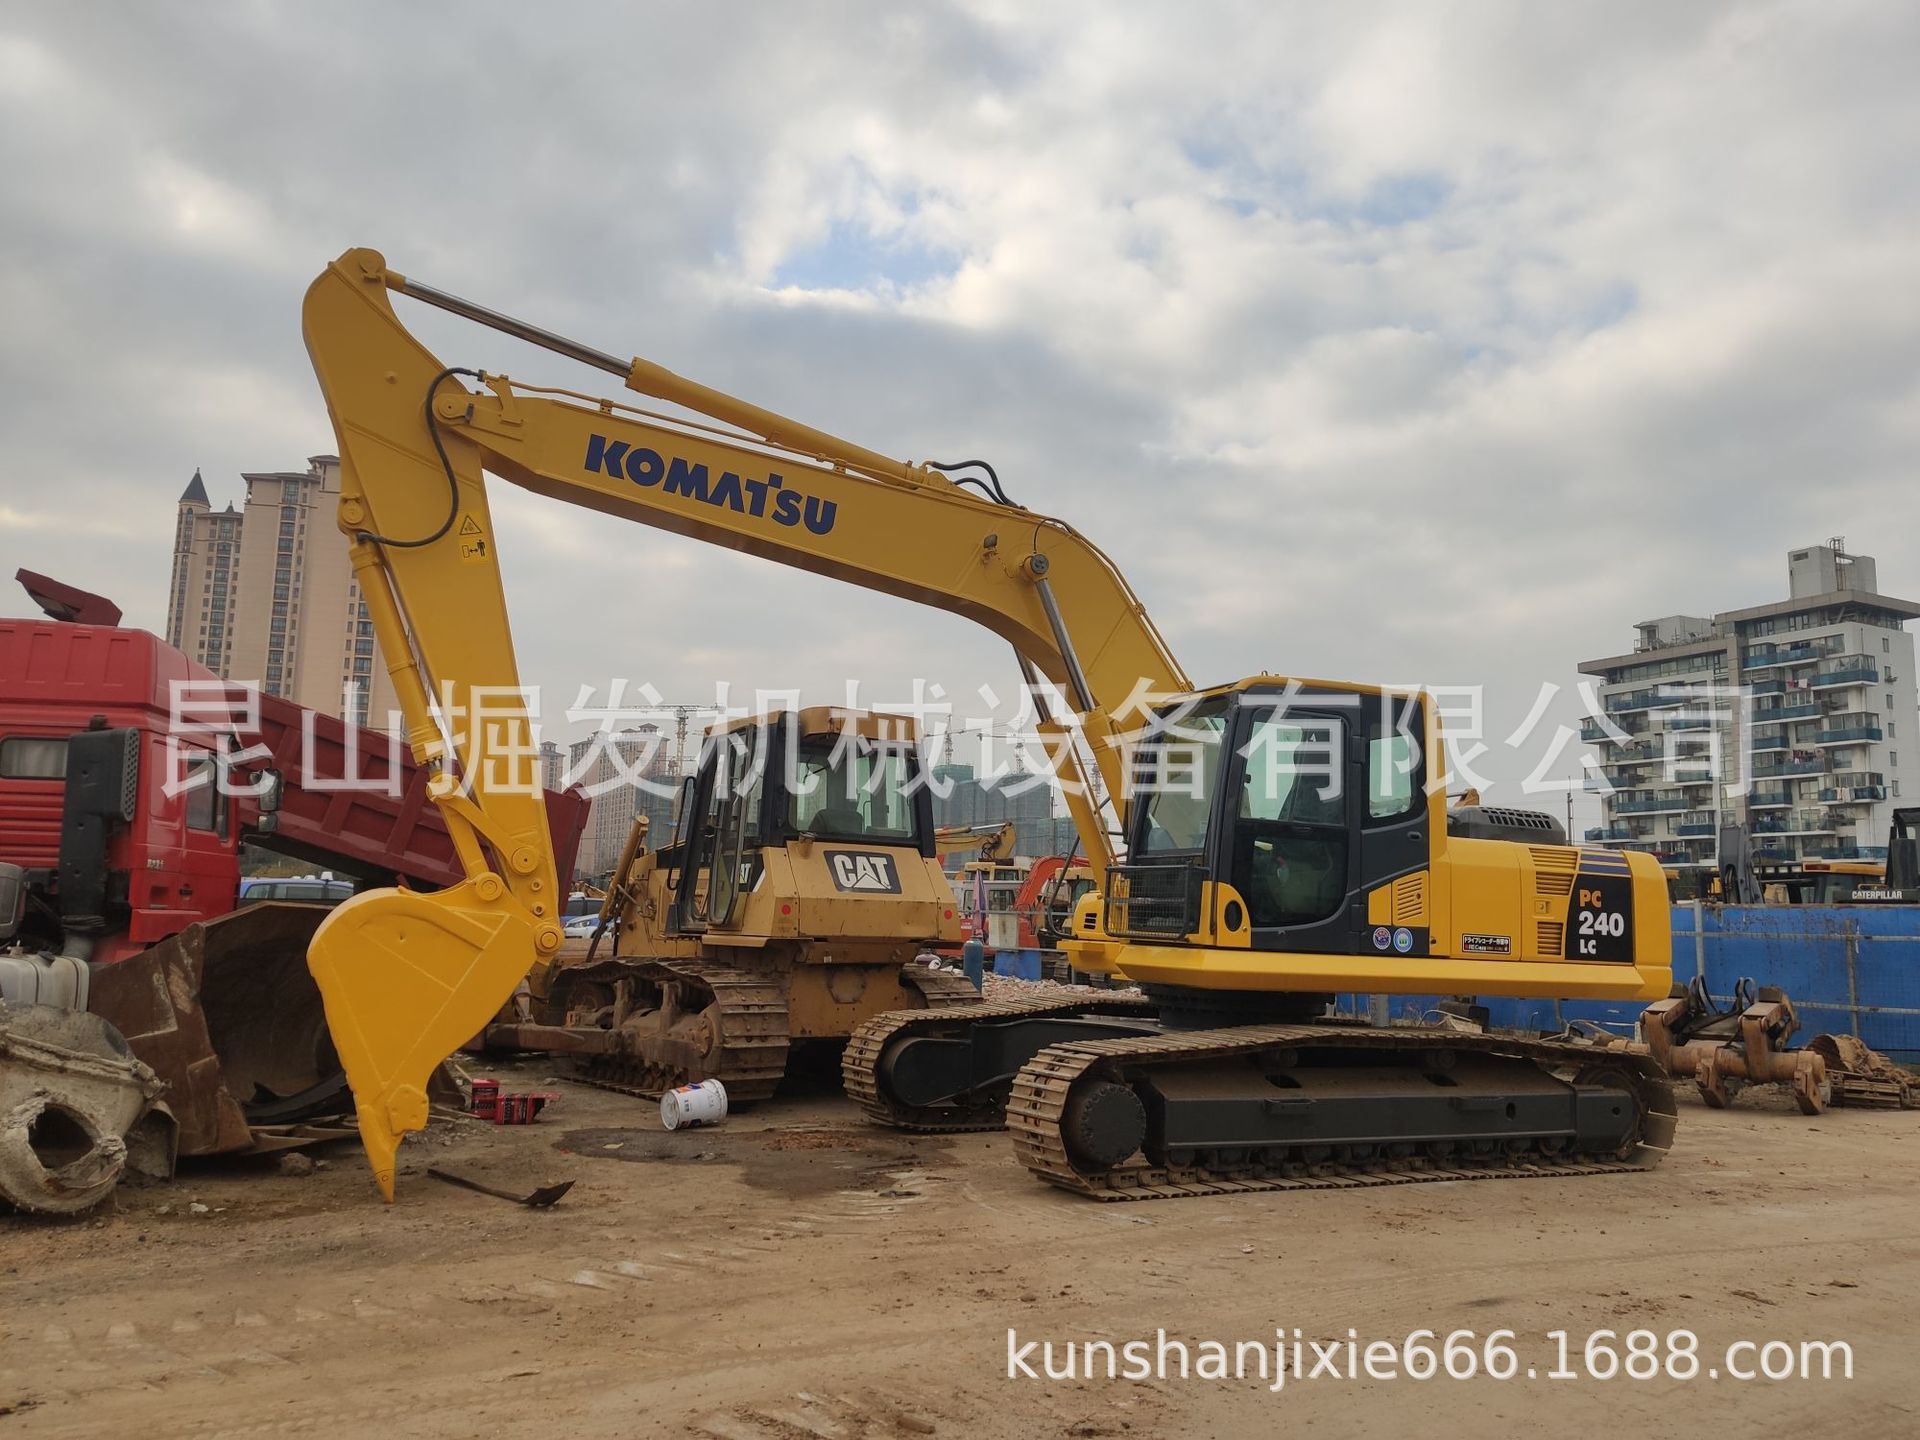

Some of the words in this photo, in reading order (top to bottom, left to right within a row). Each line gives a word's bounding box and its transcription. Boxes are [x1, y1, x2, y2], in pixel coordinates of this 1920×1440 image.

[584, 433, 838, 535] KOMATSU
[833, 854, 892, 890] CAT
[1579, 889, 1602, 908] PC
[1852, 890, 1903, 900] CATERPILLAR
[1578, 911, 1625, 937] 240
[1579, 939, 1597, 955] LC
